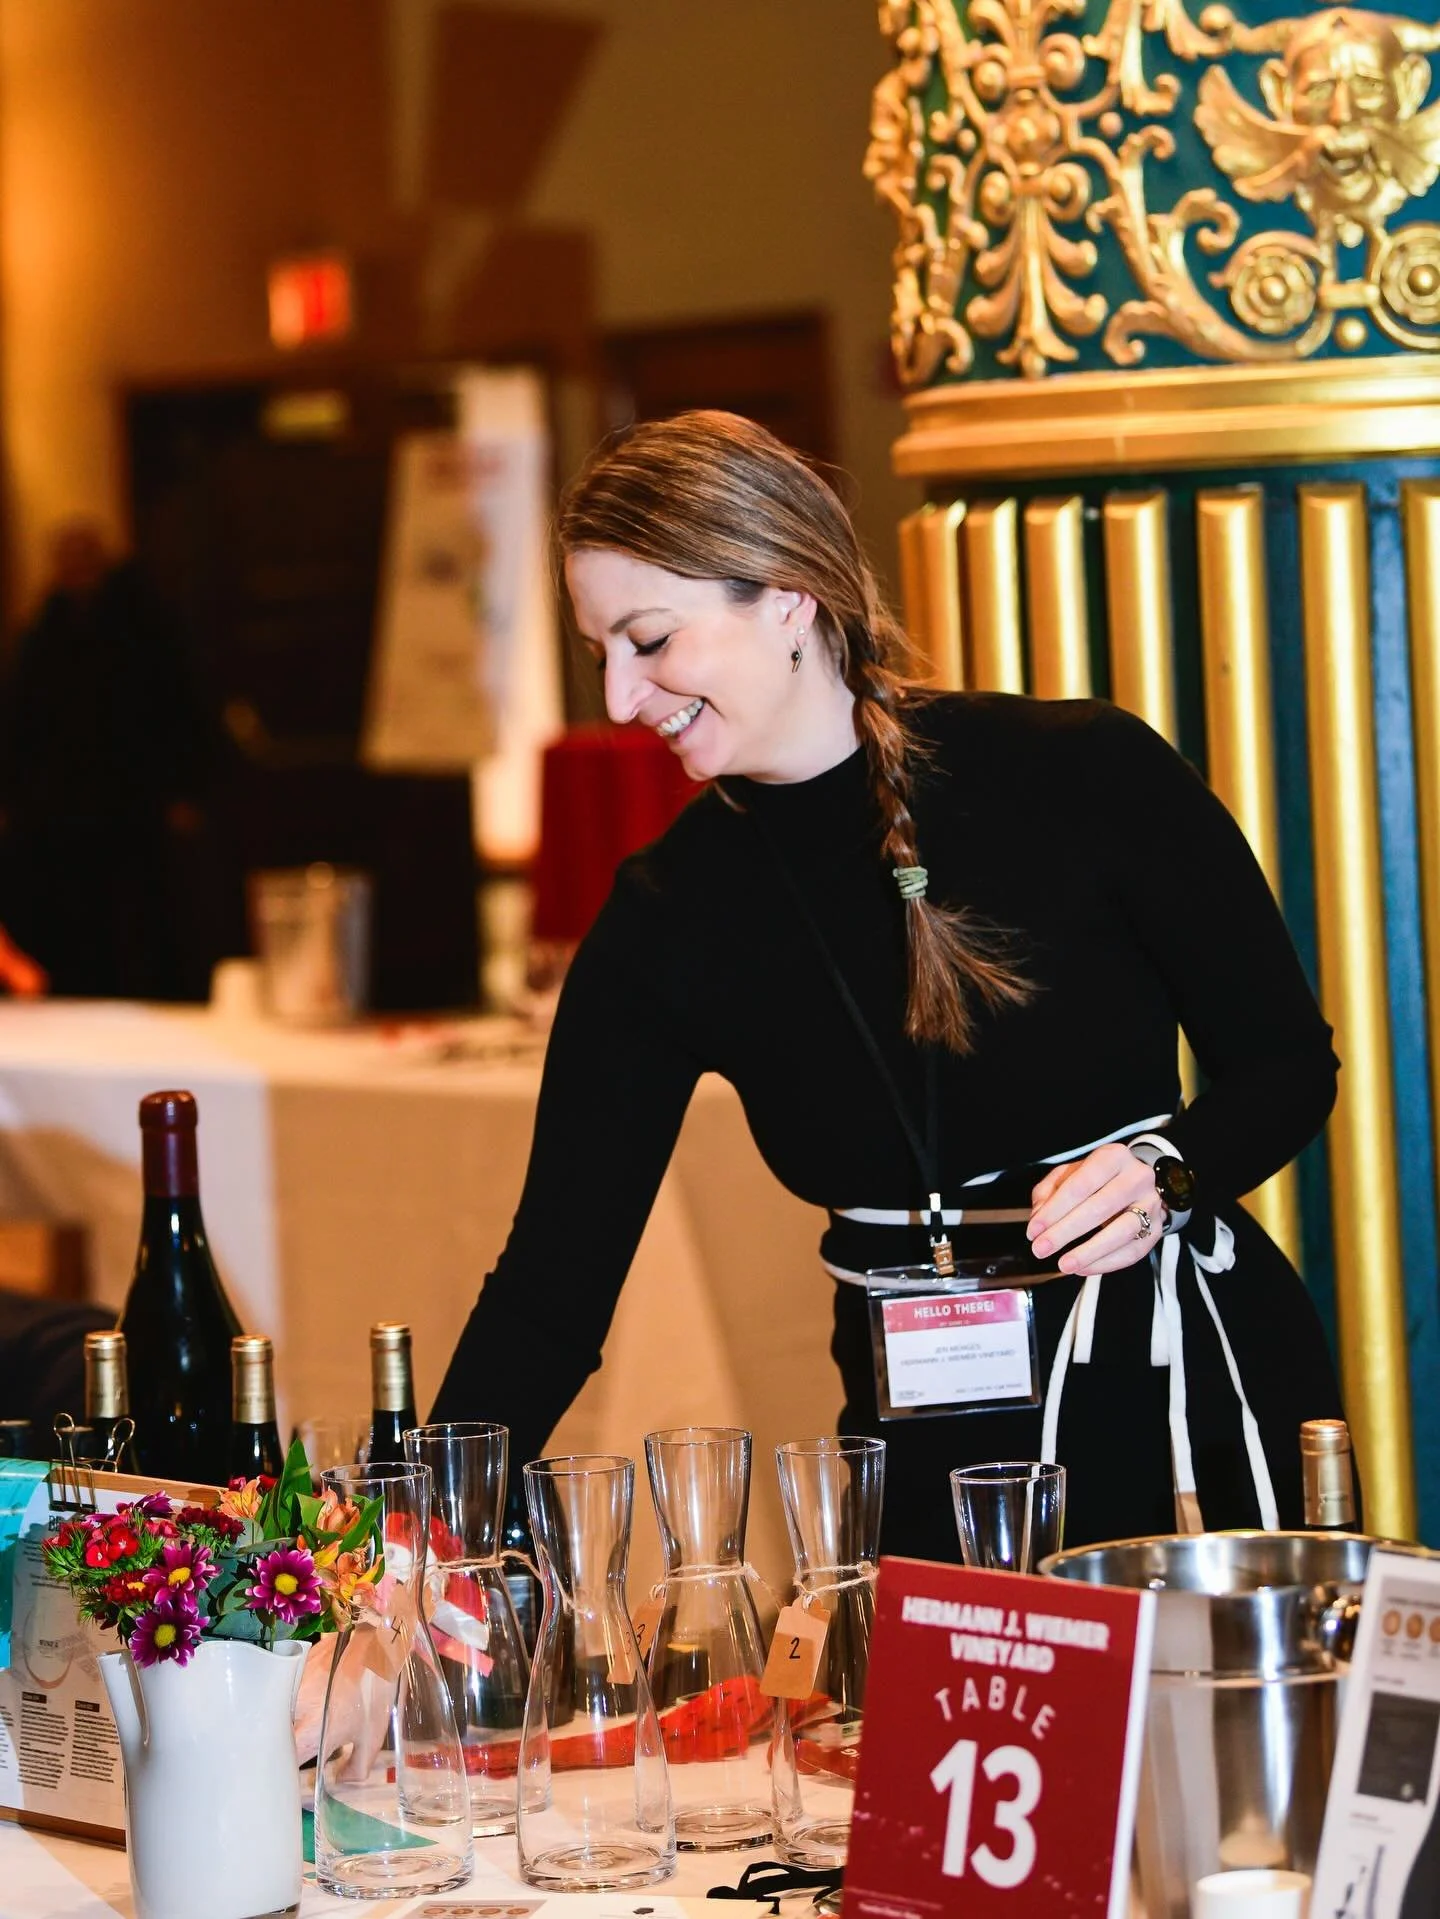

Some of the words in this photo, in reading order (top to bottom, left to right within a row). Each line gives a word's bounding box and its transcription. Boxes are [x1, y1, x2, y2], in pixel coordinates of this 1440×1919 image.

[913, 1304, 952, 1319] HELLO
[954, 1300, 995, 1315] THERE!
[391, 1616, 403, 1644] 4
[902, 1595, 1004, 1636] HERMANN
[1004, 1610, 1023, 1638] J.
[1025, 1612, 1110, 1652] WIEMER
[789, 1637, 801, 1659] 2
[950, 1632, 1056, 1674] VINEYARD
[934, 1675, 1056, 1740] TABLE
[930, 1739, 1043, 1889] 13
